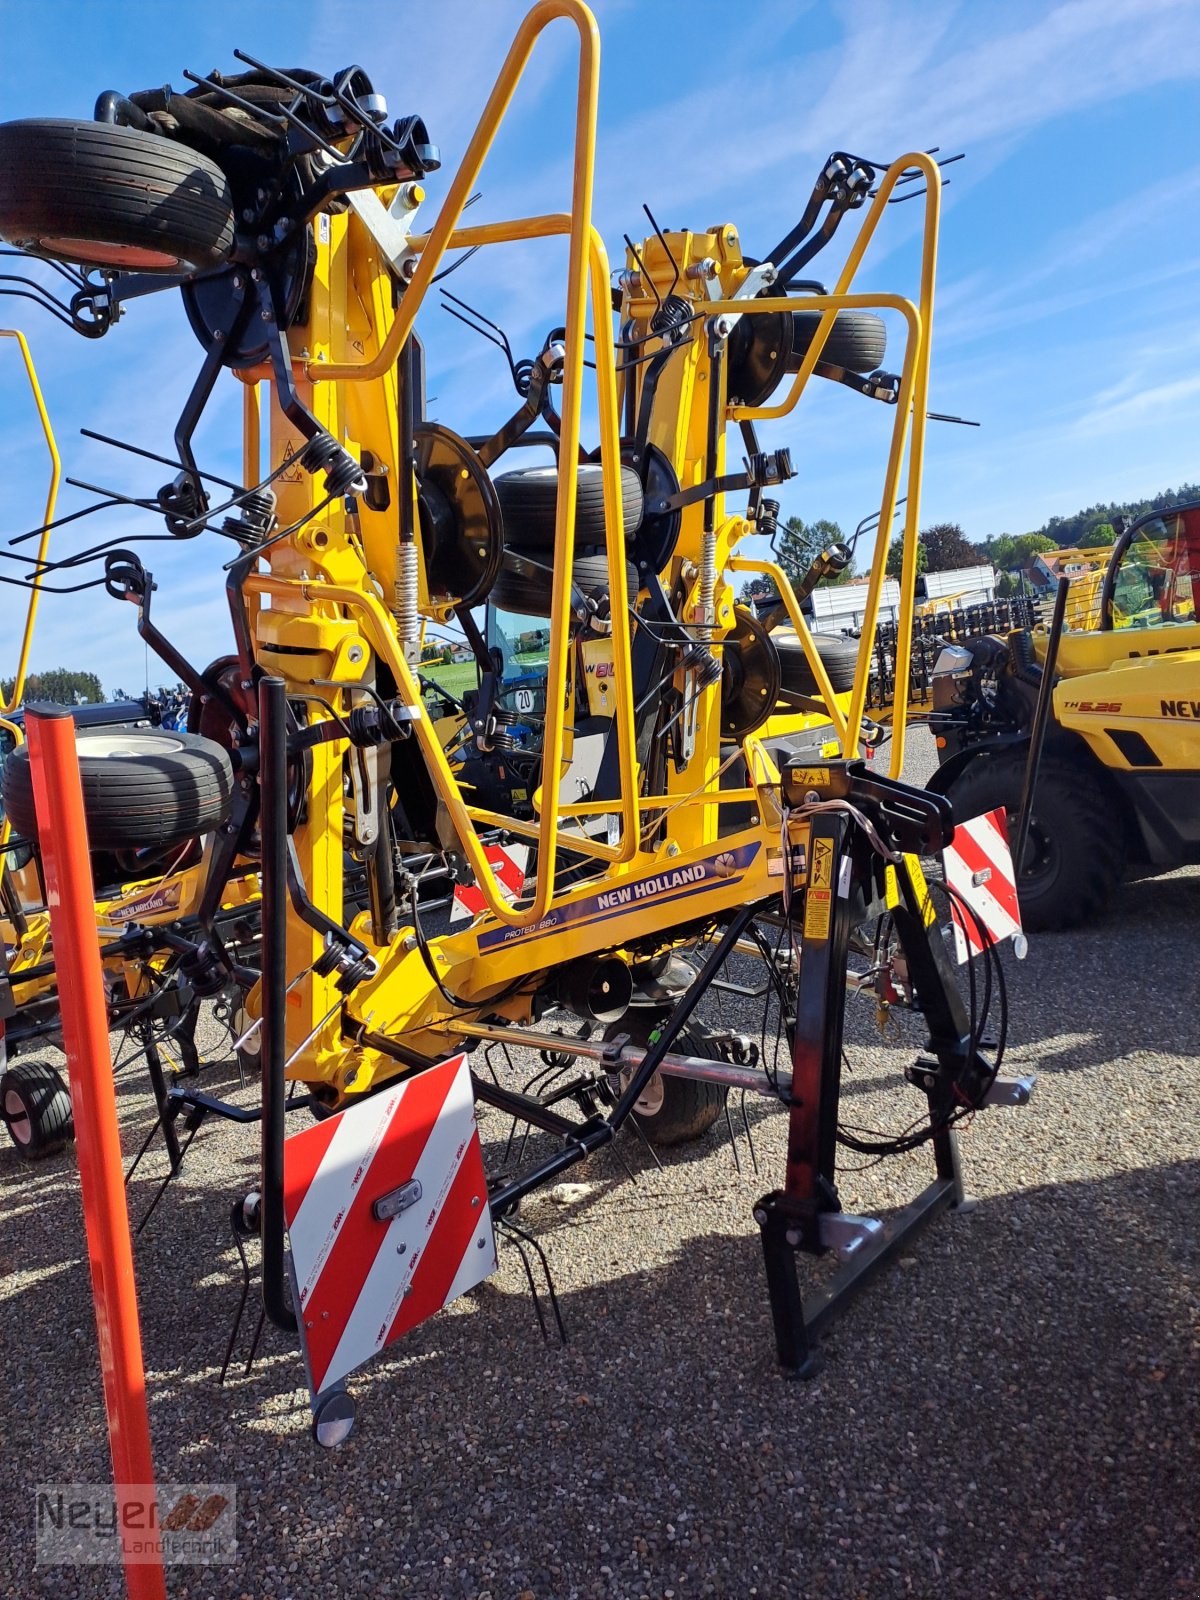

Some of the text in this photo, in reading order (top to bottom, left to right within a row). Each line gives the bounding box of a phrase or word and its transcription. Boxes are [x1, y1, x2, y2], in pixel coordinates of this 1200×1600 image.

[518, 690, 531, 709] 20
[597, 864, 706, 910] NEW HOLLAND
[504, 924, 536, 940] PROTED
[352, 1166, 364, 1185] WGF
[332, 1212, 344, 1232] WGF
[376, 1323, 387, 1342] WGF
